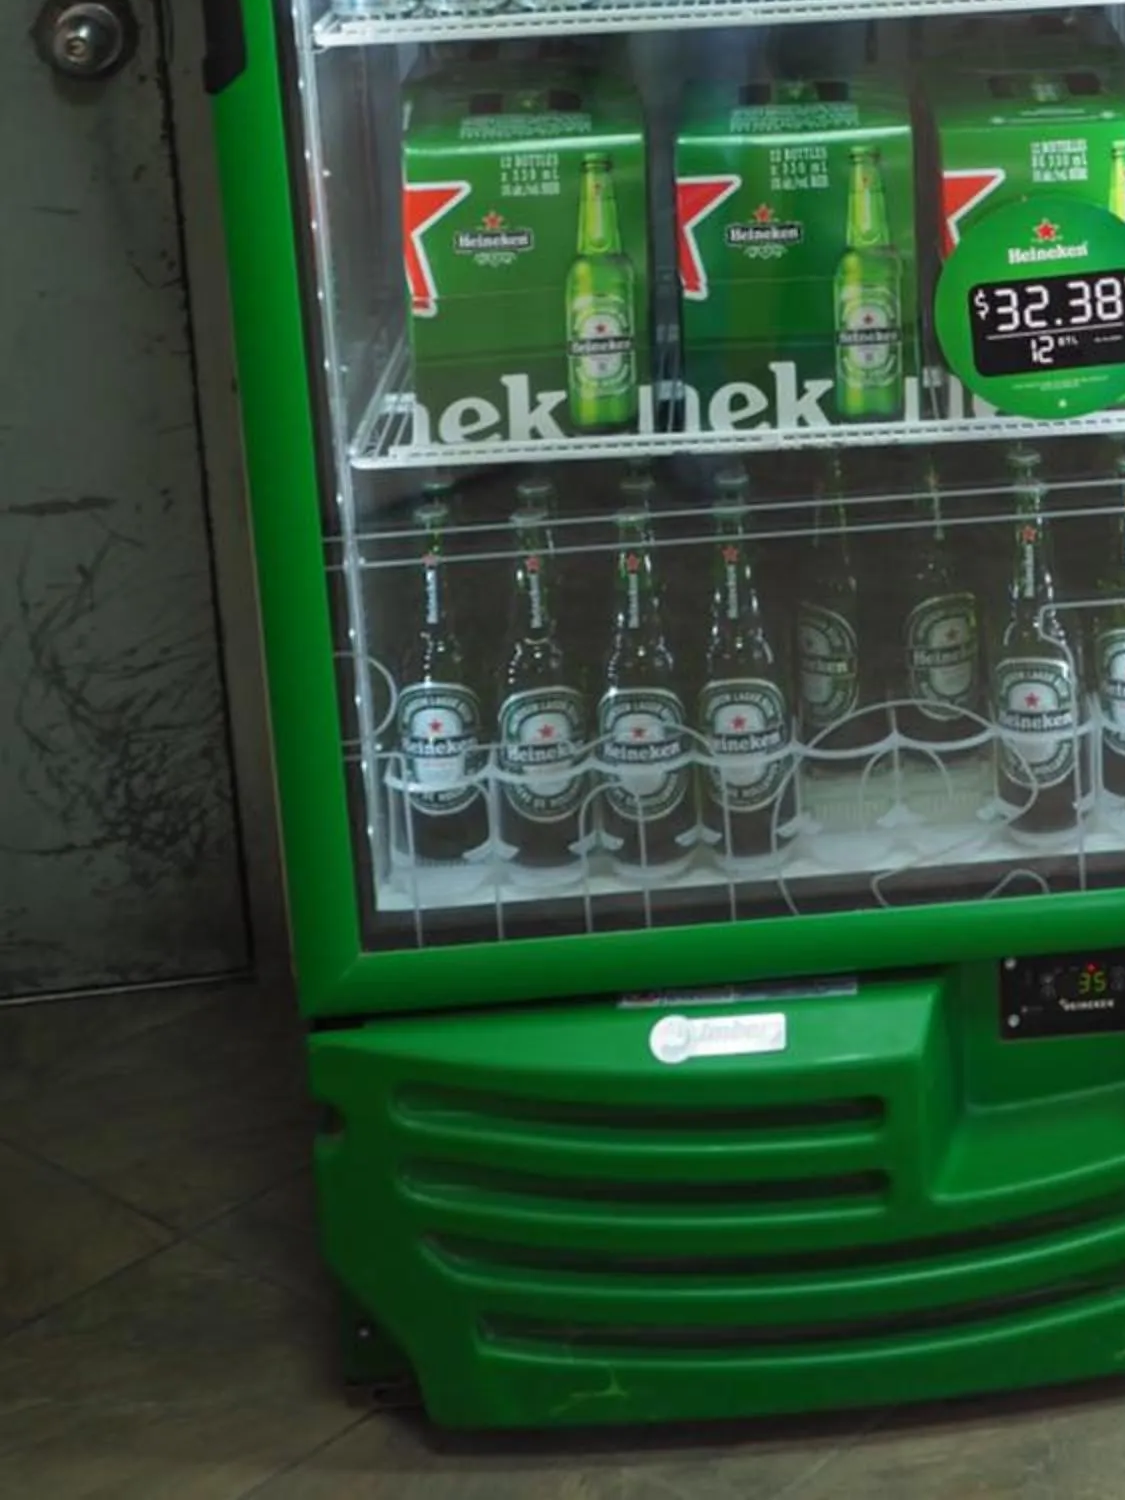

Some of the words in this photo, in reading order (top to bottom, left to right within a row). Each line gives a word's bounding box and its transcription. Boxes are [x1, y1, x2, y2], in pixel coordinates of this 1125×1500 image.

[458, 233, 530, 249] Heineken
[1007, 242, 1089, 265] Heineken
[974, 276, 1125, 333] $32.38
[1030, 334, 1056, 365] 12
[1077, 971, 1108, 996] 35
